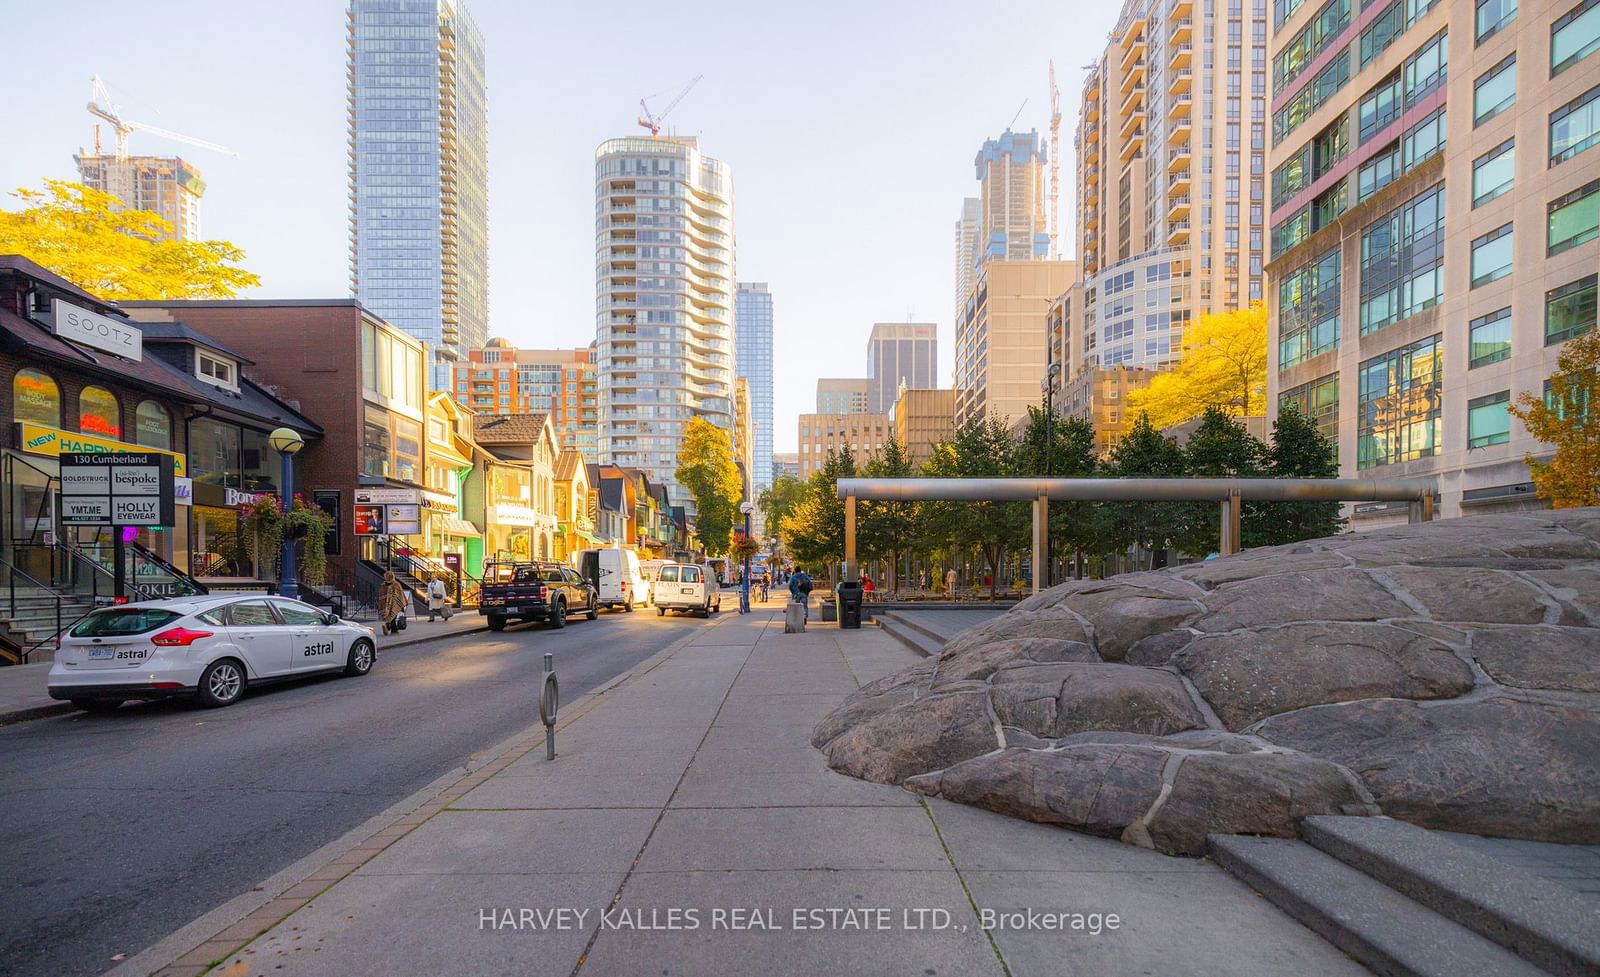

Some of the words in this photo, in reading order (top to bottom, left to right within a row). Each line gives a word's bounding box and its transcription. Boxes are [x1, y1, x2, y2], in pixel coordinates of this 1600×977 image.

[67, 312, 133, 346] SOOTZ
[27, 432, 56, 448] NEW
[74, 455, 91, 464] 130
[91, 455, 148, 464] Cumberland
[115, 473, 157, 487] bespoke
[70, 505, 102, 515] YMT.ME
[117, 502, 156, 513] HOLLY
[117, 512, 156, 520] EYEWEAR
[304, 640, 334, 656] astral
[117, 649, 148, 659] astral
